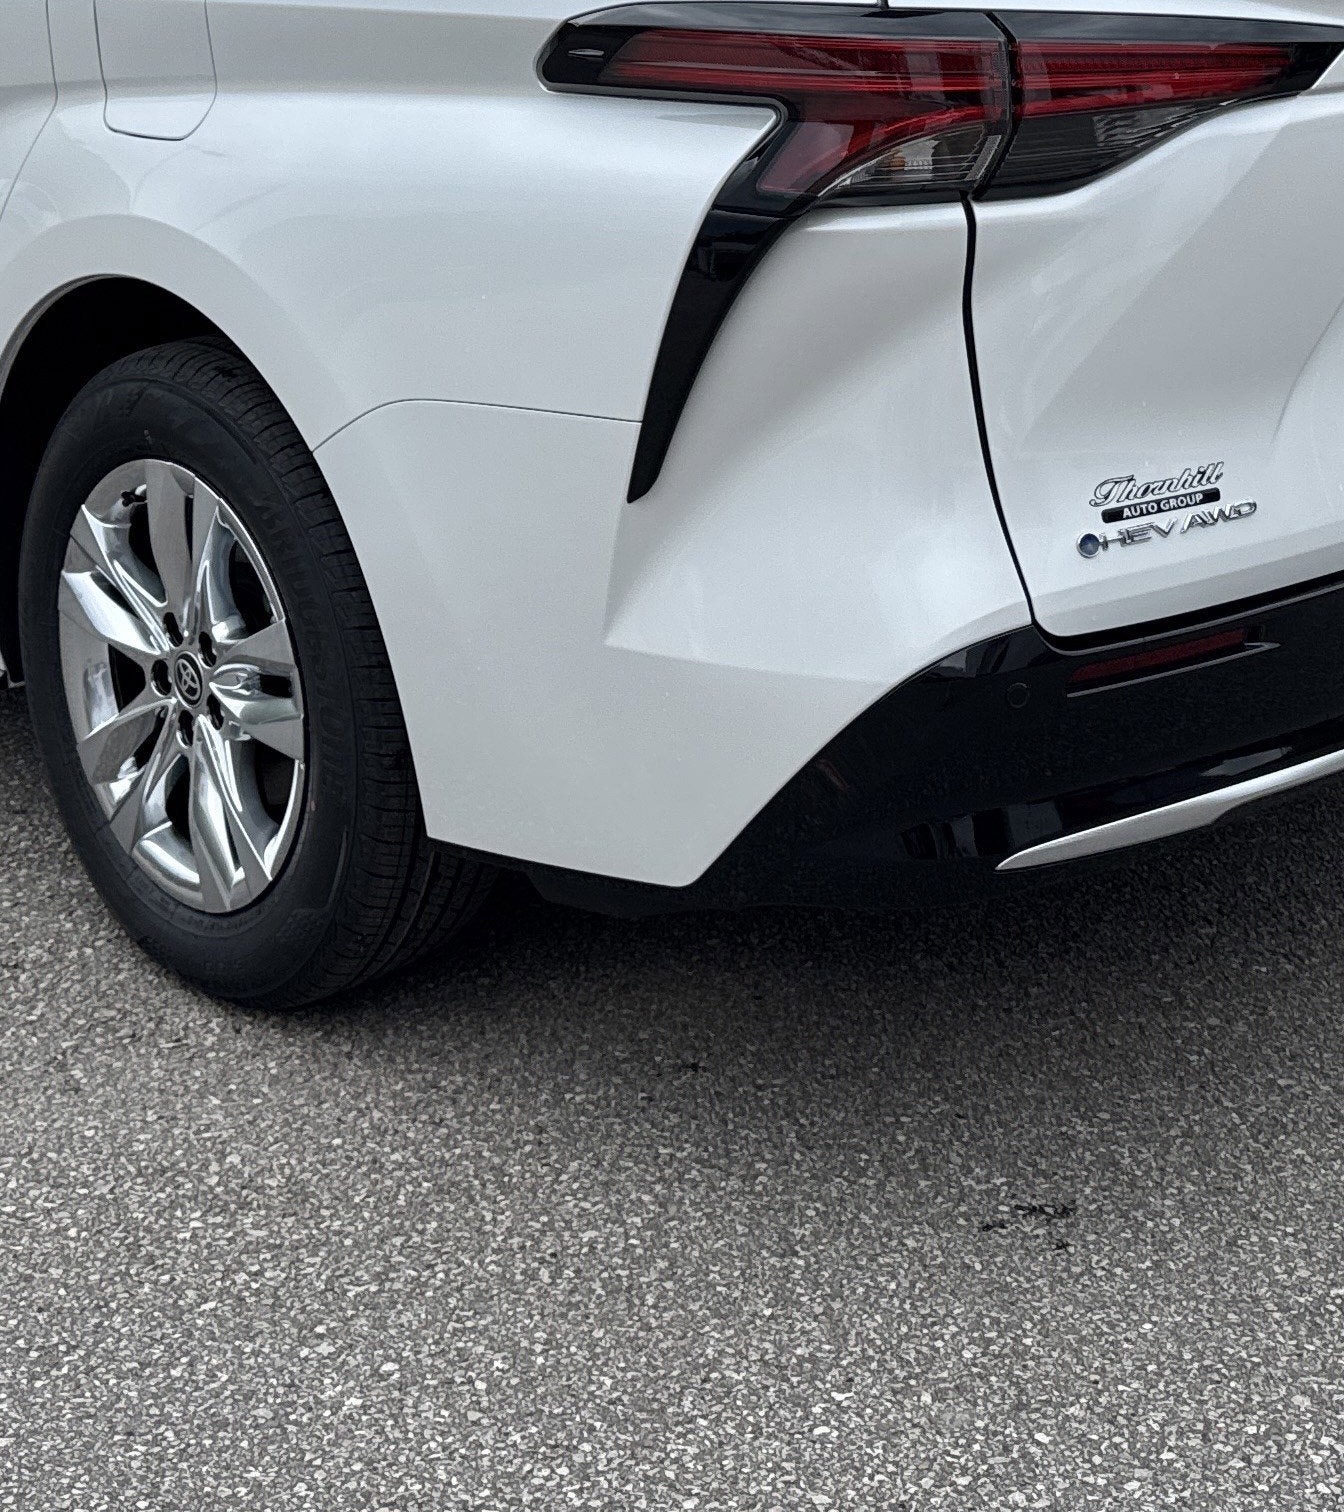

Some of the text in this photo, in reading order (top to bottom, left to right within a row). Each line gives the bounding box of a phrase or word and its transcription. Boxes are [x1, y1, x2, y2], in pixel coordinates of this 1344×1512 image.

[1089, 461, 1225, 508] Thornhill
[1122, 491, 1204, 519] AUTO GROUP
[1180, 498, 1258, 534] AWD
